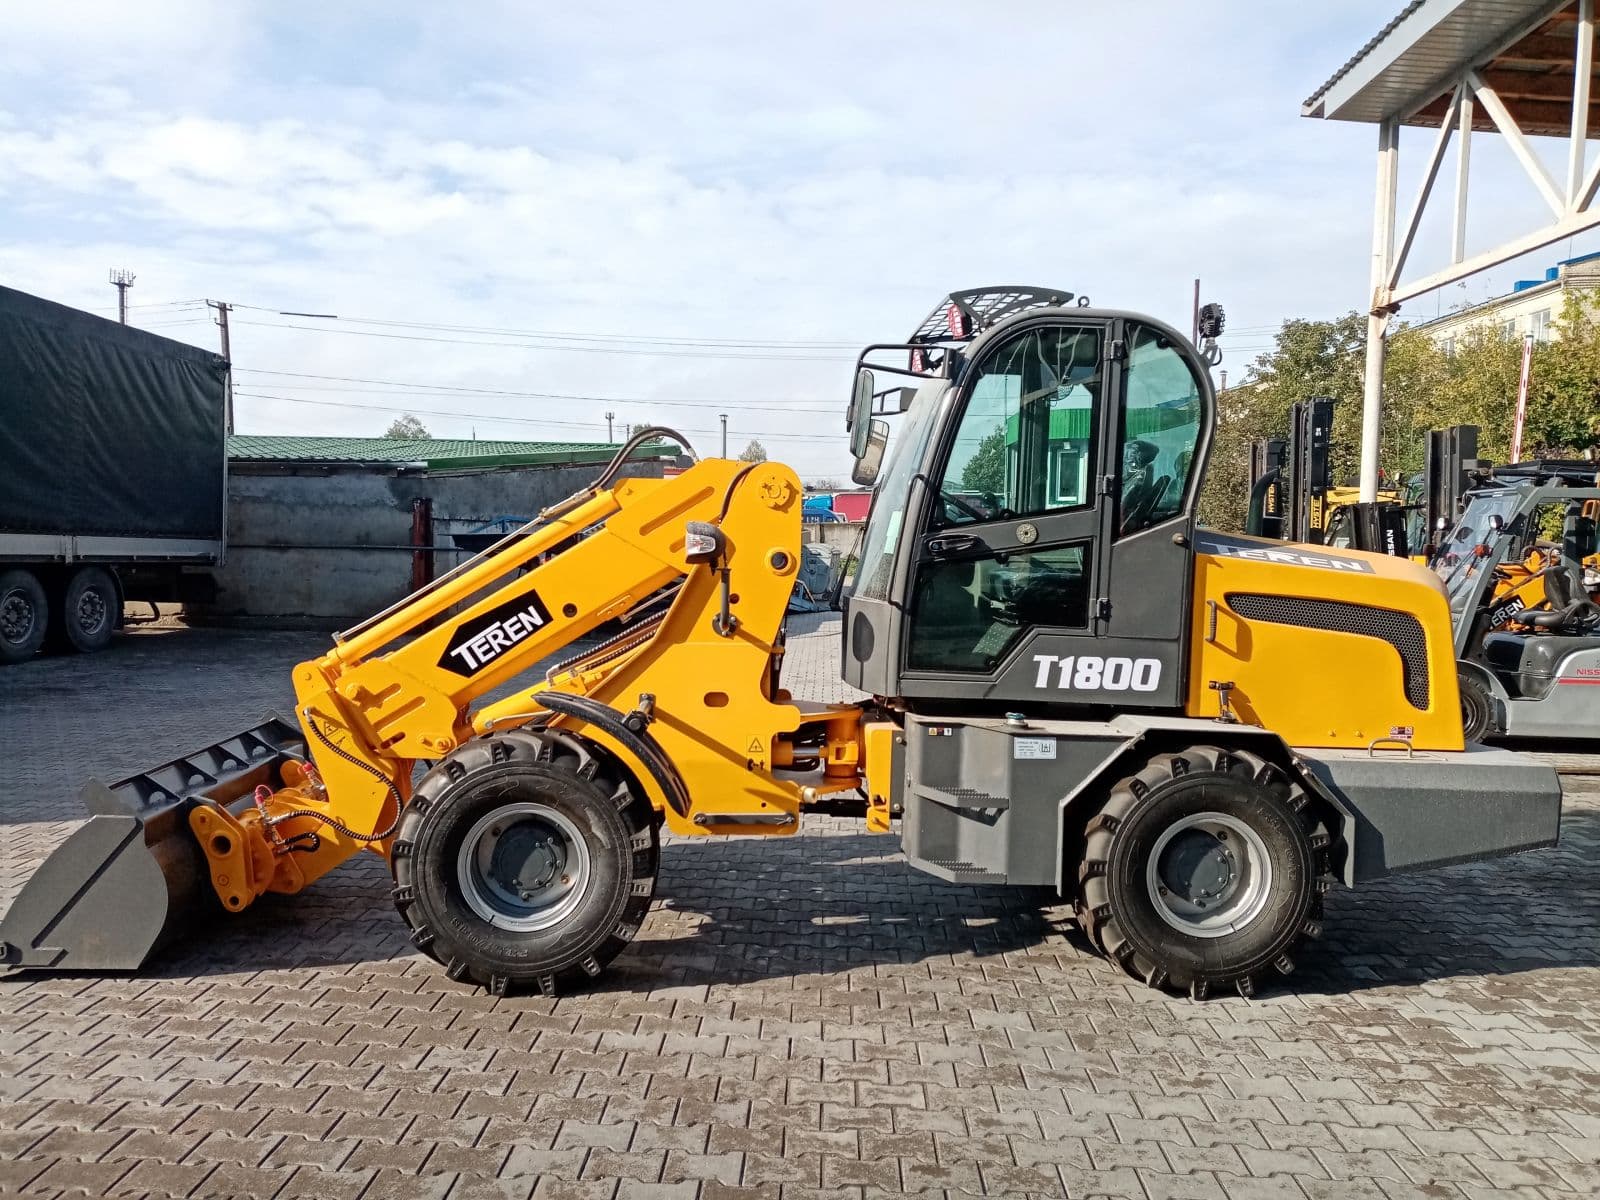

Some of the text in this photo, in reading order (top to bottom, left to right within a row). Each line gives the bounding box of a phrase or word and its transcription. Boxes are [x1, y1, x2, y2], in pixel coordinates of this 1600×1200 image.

[1200, 542, 1364, 571] TEREN
[450, 605, 544, 670] TEREN
[1033, 655, 1162, 692] T1800
